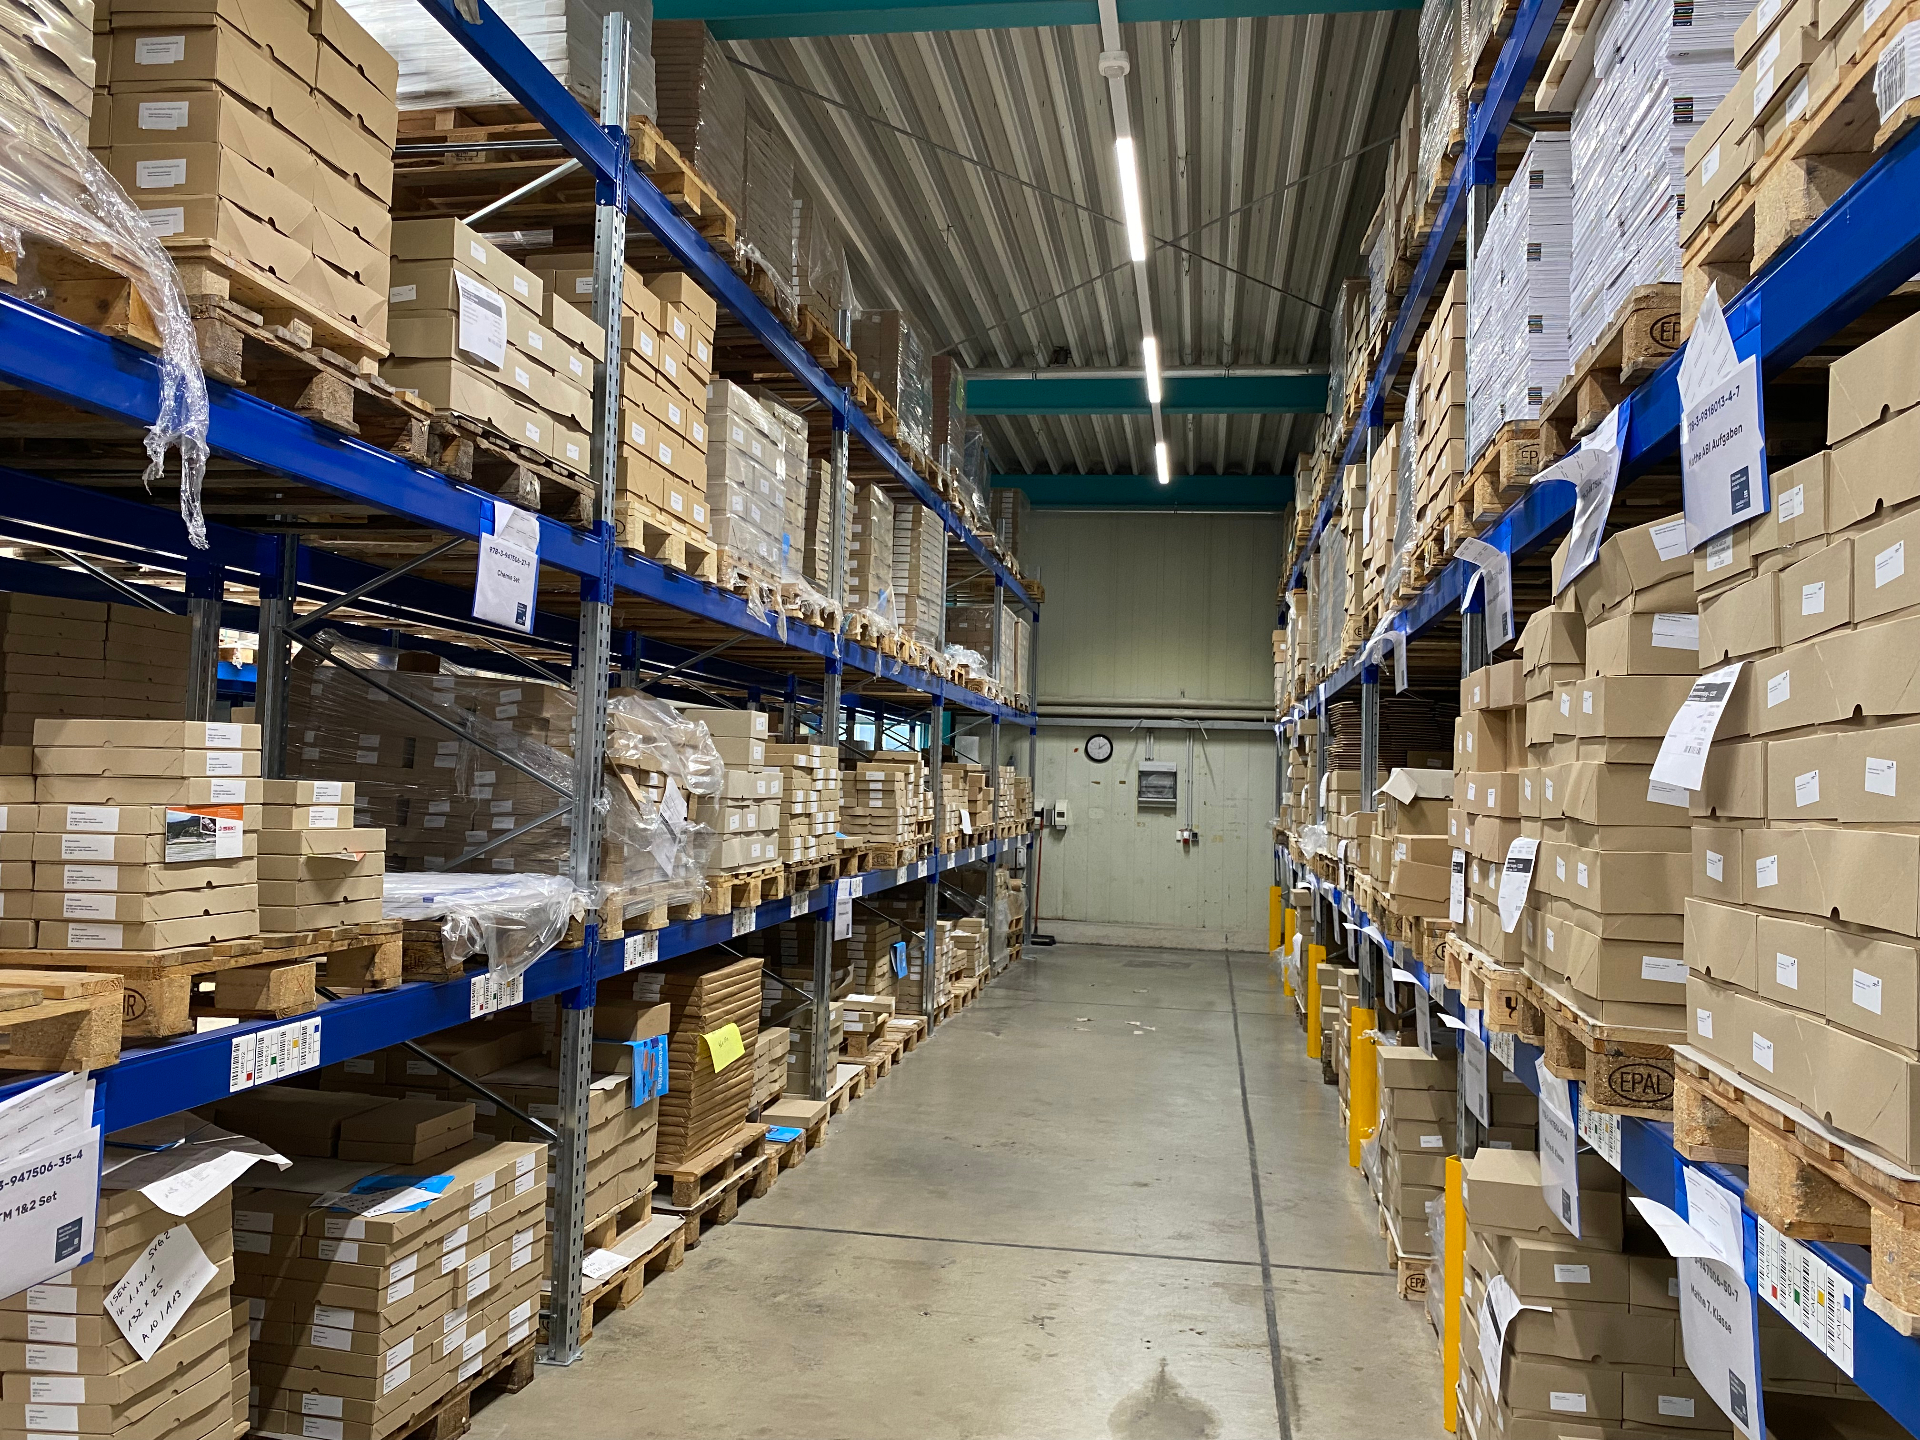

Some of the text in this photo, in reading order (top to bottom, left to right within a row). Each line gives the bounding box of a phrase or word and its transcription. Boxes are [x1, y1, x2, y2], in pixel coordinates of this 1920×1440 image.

[1711, 424, 1743, 451] Aufgaben
[1620, 1071, 1668, 1096] EPAL
[15, 1199, 36, 1216] 1&2
[39, 1190, 57, 1207] Set
[1410, 1277, 1426, 1289] EPA
[1690, 1283, 1732, 1335] Mathe 7. Klasse
